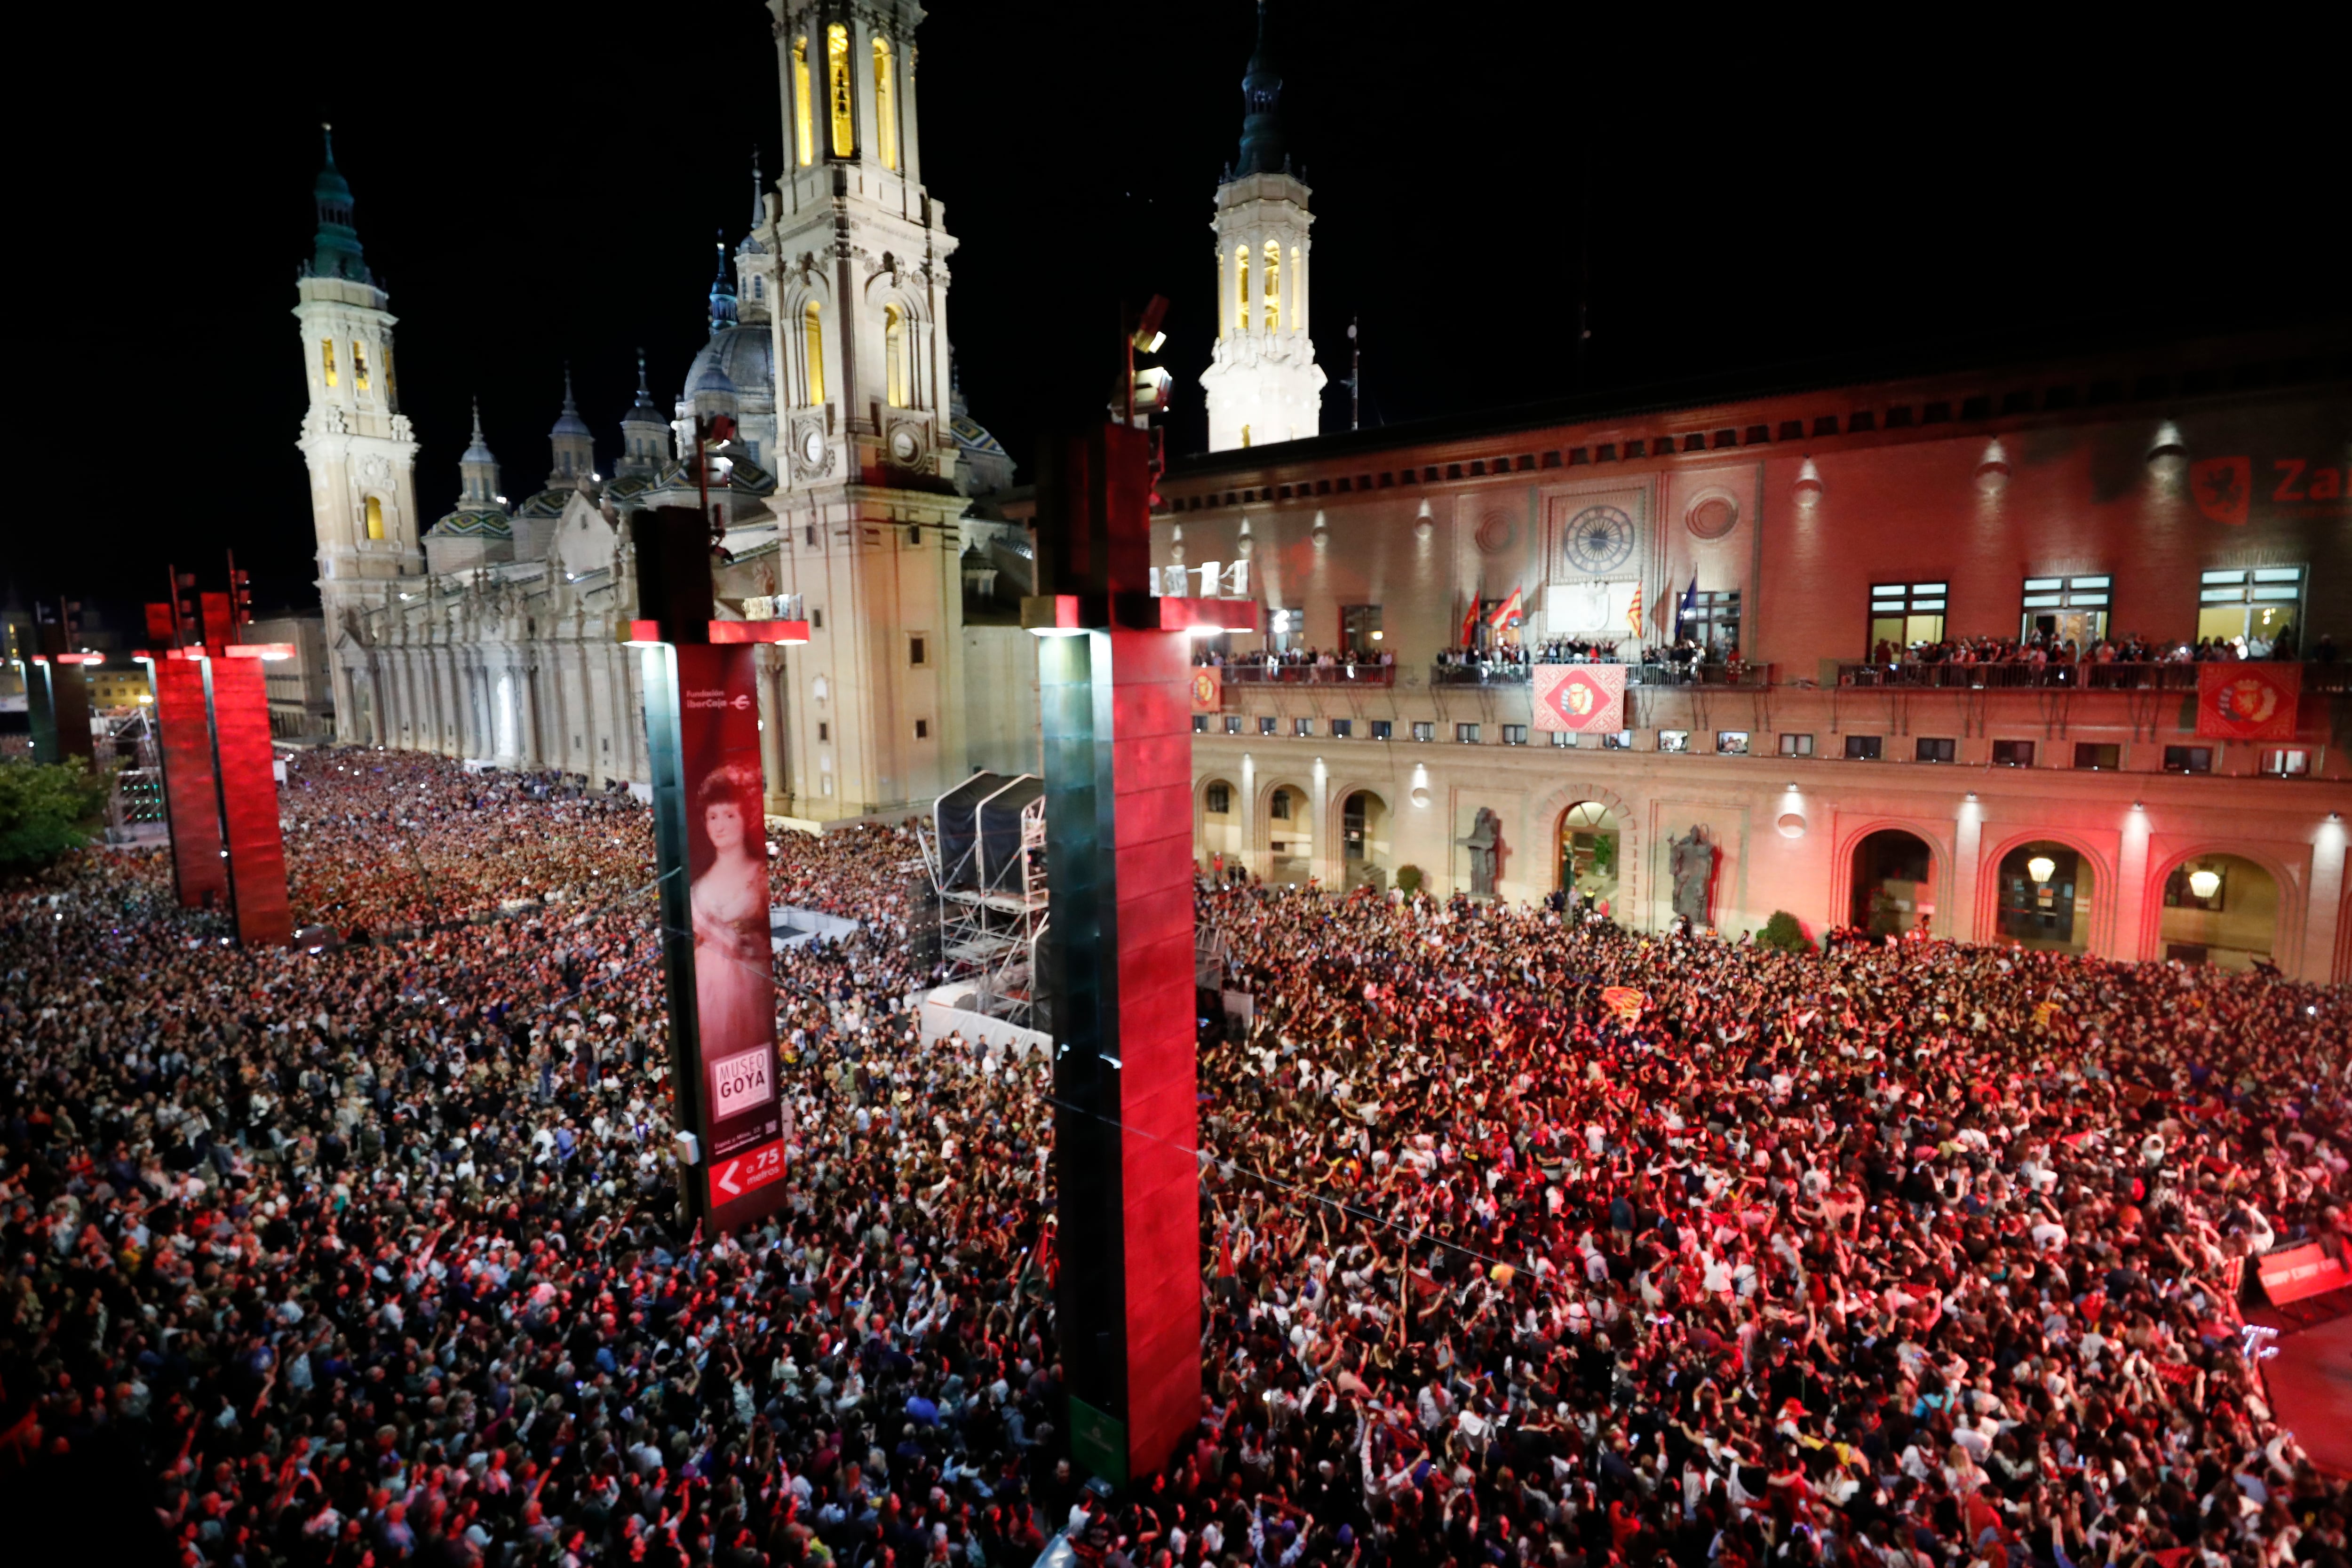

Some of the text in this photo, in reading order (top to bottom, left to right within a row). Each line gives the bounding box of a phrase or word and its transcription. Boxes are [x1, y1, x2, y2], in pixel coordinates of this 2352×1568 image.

[720, 1053, 763, 1082] MUSEO
[721, 1070, 764, 1098] GOYA
[746, 1148, 779, 1174] a 75
[747, 1166, 779, 1185] metros
